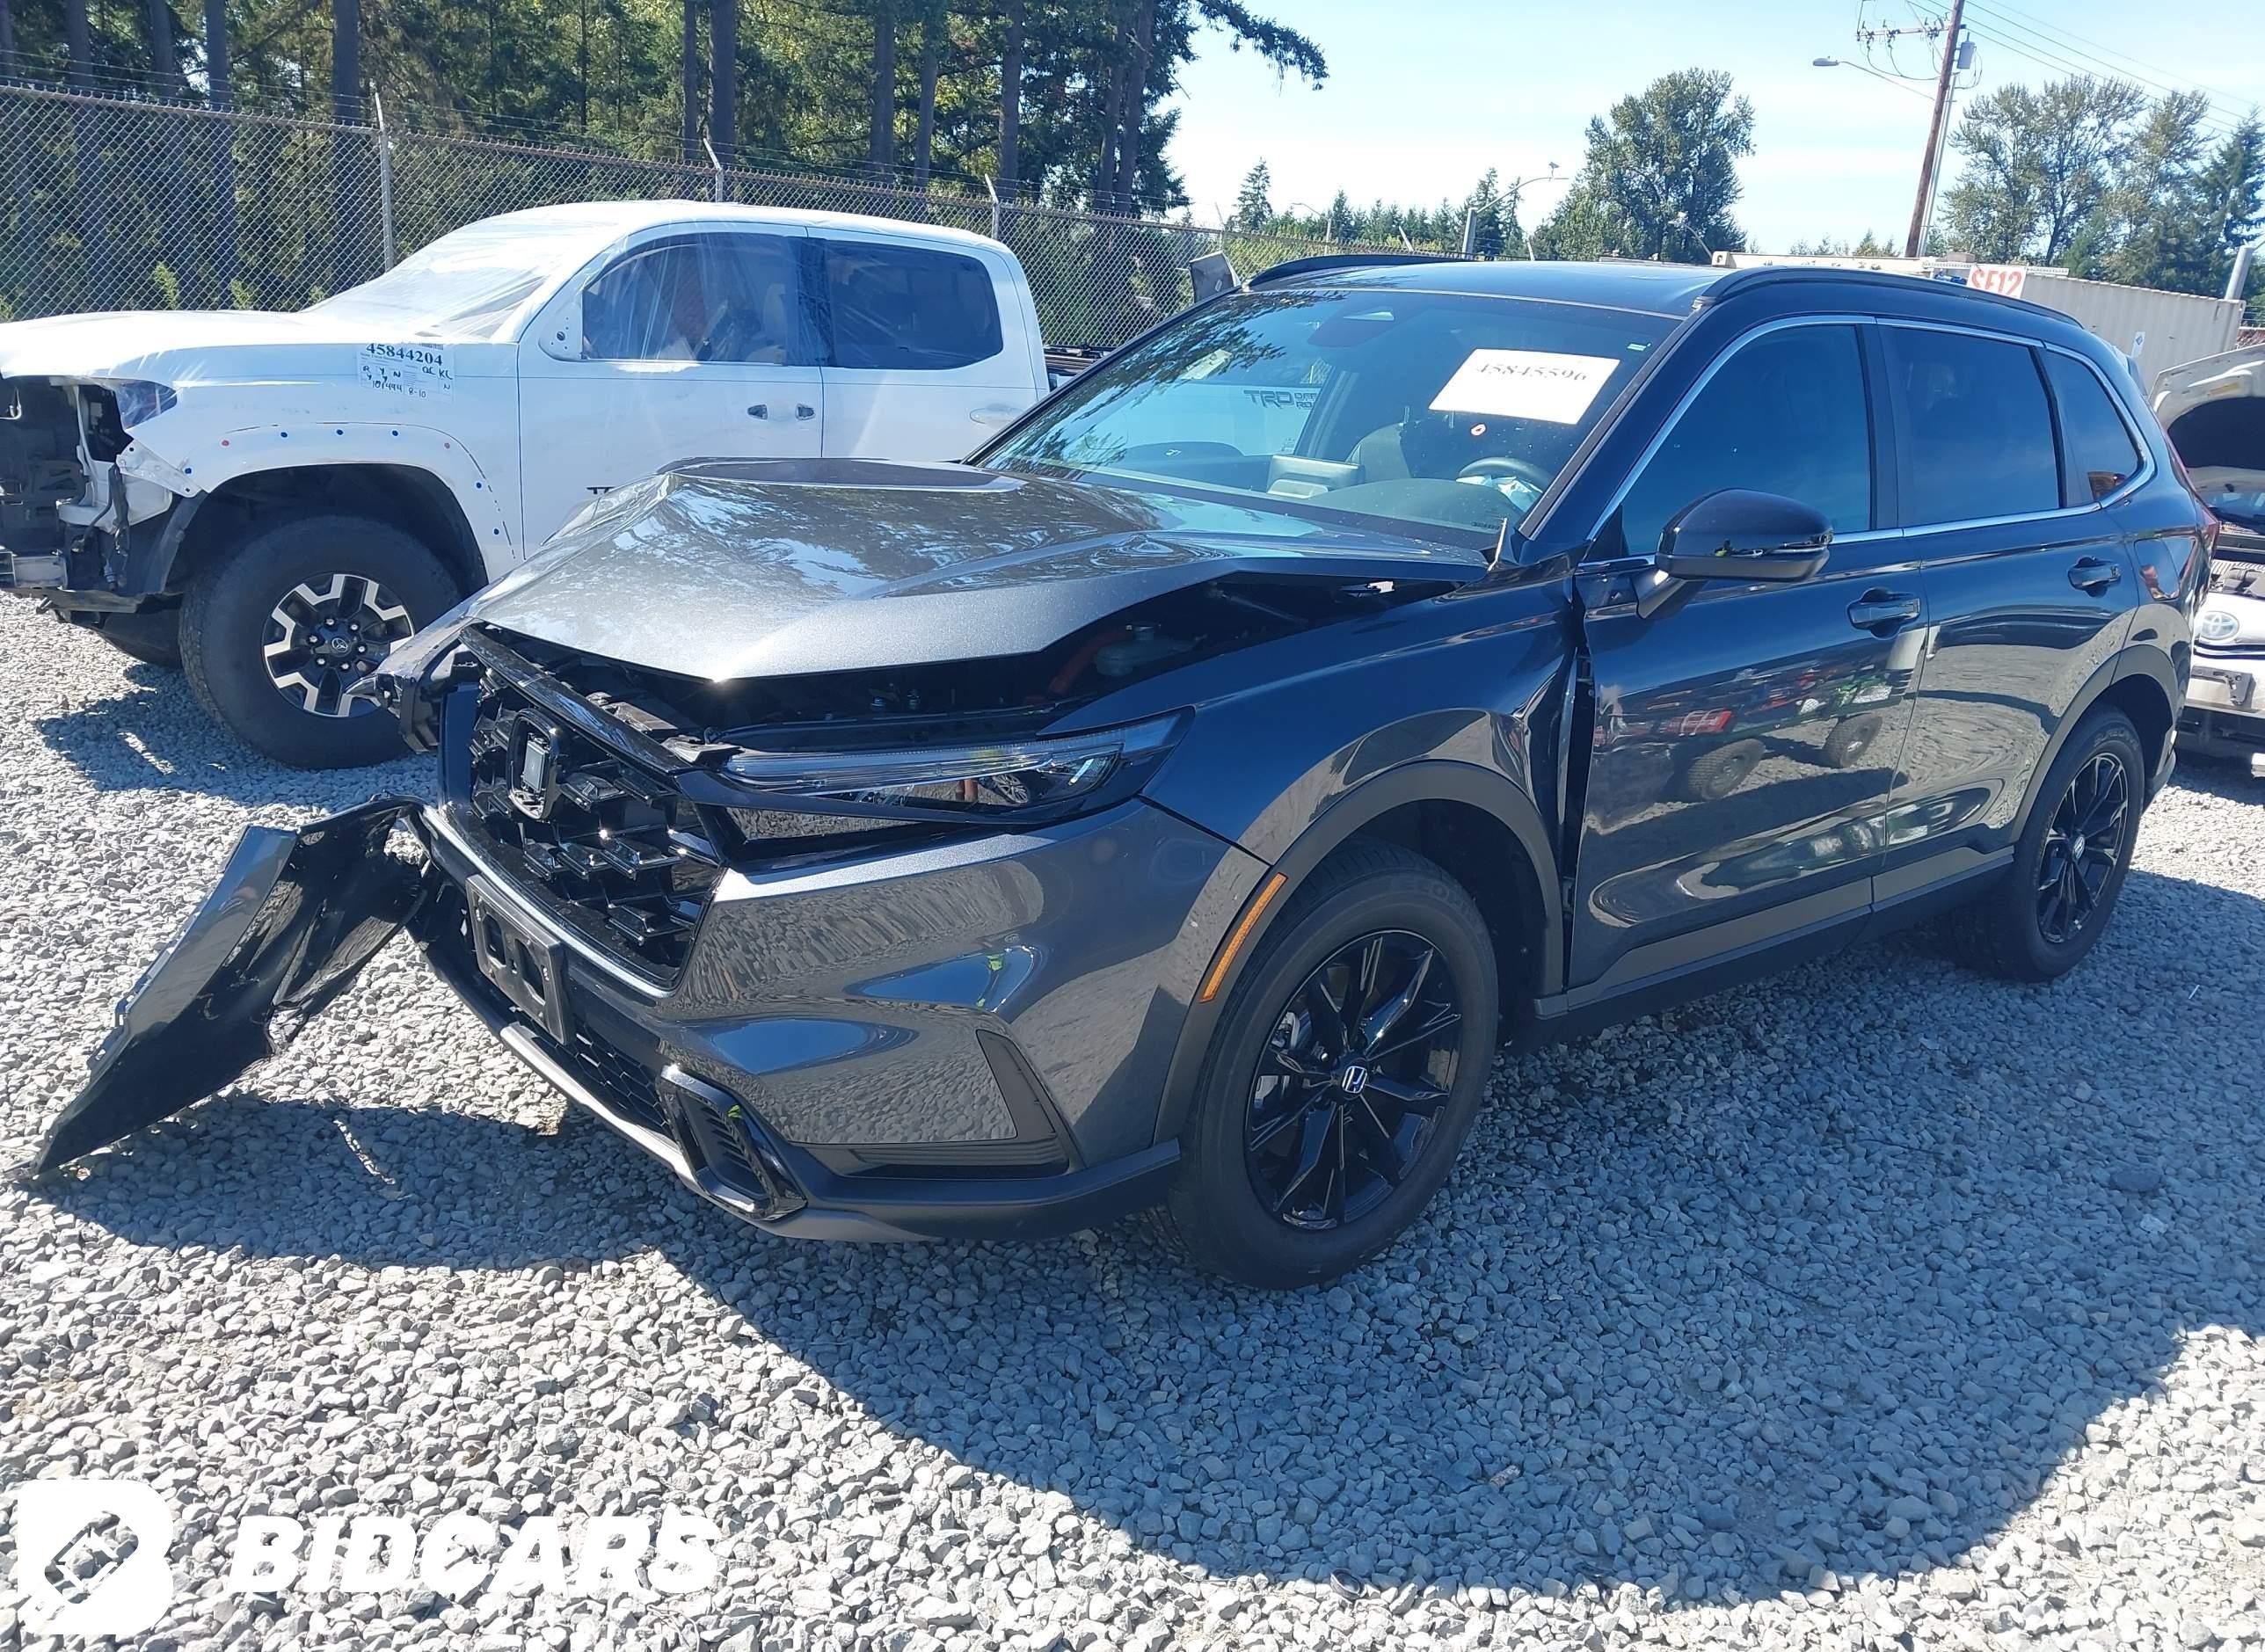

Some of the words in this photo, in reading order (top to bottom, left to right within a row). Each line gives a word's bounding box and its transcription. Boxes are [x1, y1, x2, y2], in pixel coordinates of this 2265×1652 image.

[366, 343, 443, 366] 45844204
[1476, 363, 1588, 381] 45845596
[1243, 389, 1294, 409] TRD
[1296, 401, 1314, 410] RO
